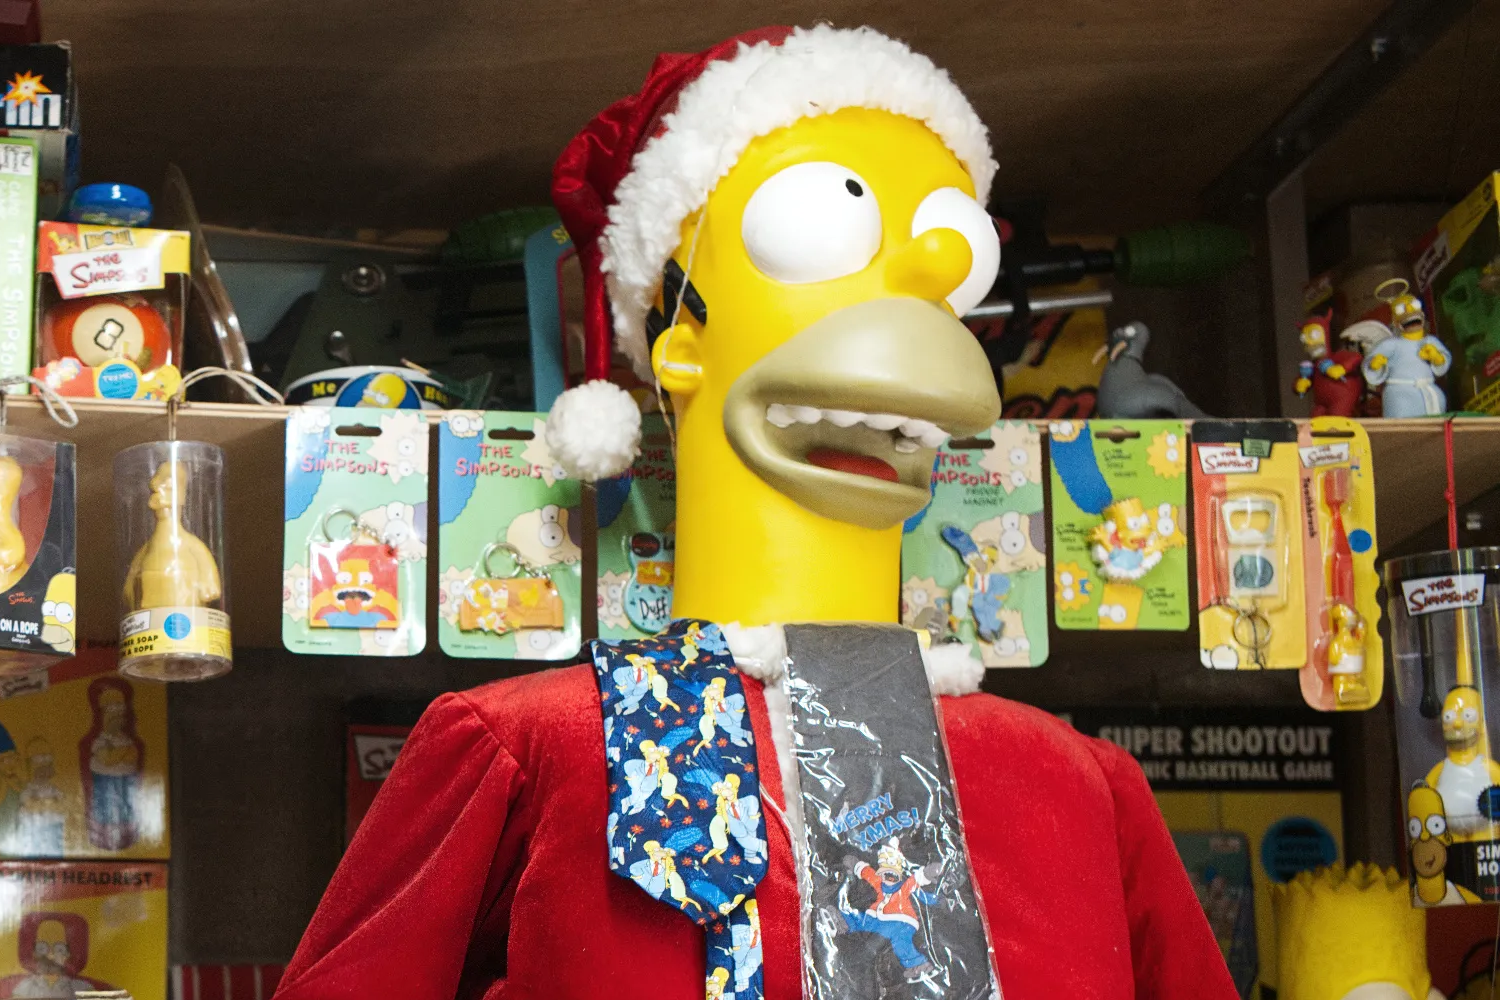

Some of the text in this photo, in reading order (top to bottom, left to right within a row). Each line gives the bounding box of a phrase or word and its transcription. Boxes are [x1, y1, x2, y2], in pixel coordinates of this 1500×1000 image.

[92, 252, 123, 267] THE
[0, 233, 26, 385] THE SIMPSON
[94, 318, 125, 351] 8
[312, 381, 337, 398] Me
[324, 439, 361, 455] THE
[479, 442, 513, 461] THE
[301, 454, 390, 476] SIMPSONS
[454, 456, 543, 479] SIMPSONS
[938, 451, 971, 467] THE
[931, 470, 1002, 487] MPSONS
[1302, 476, 1318, 538] Toothbrush
[1428, 580, 1454, 590] THE
[1409, 587, 1479, 611] SIMPSONS
[639, 597, 670, 621] Duff
[0, 618, 13, 632] ON
[13, 620, 19, 633] A
[20, 620, 39, 635] ROPE
[134, 644, 154, 653] ROPE
[137, 634, 159, 644] SOAP
[1097, 725, 1333, 756] SUPER SHOOTOUT
[1175, 761, 1280, 780] BASKETBALL
[1283, 761, 1334, 780] GAME
[828, 791, 894, 835] MERRY
[854, 807, 921, 852] XMAS!
[12, 869, 56, 884] WITH
[61, 869, 155, 887] HEADREST
